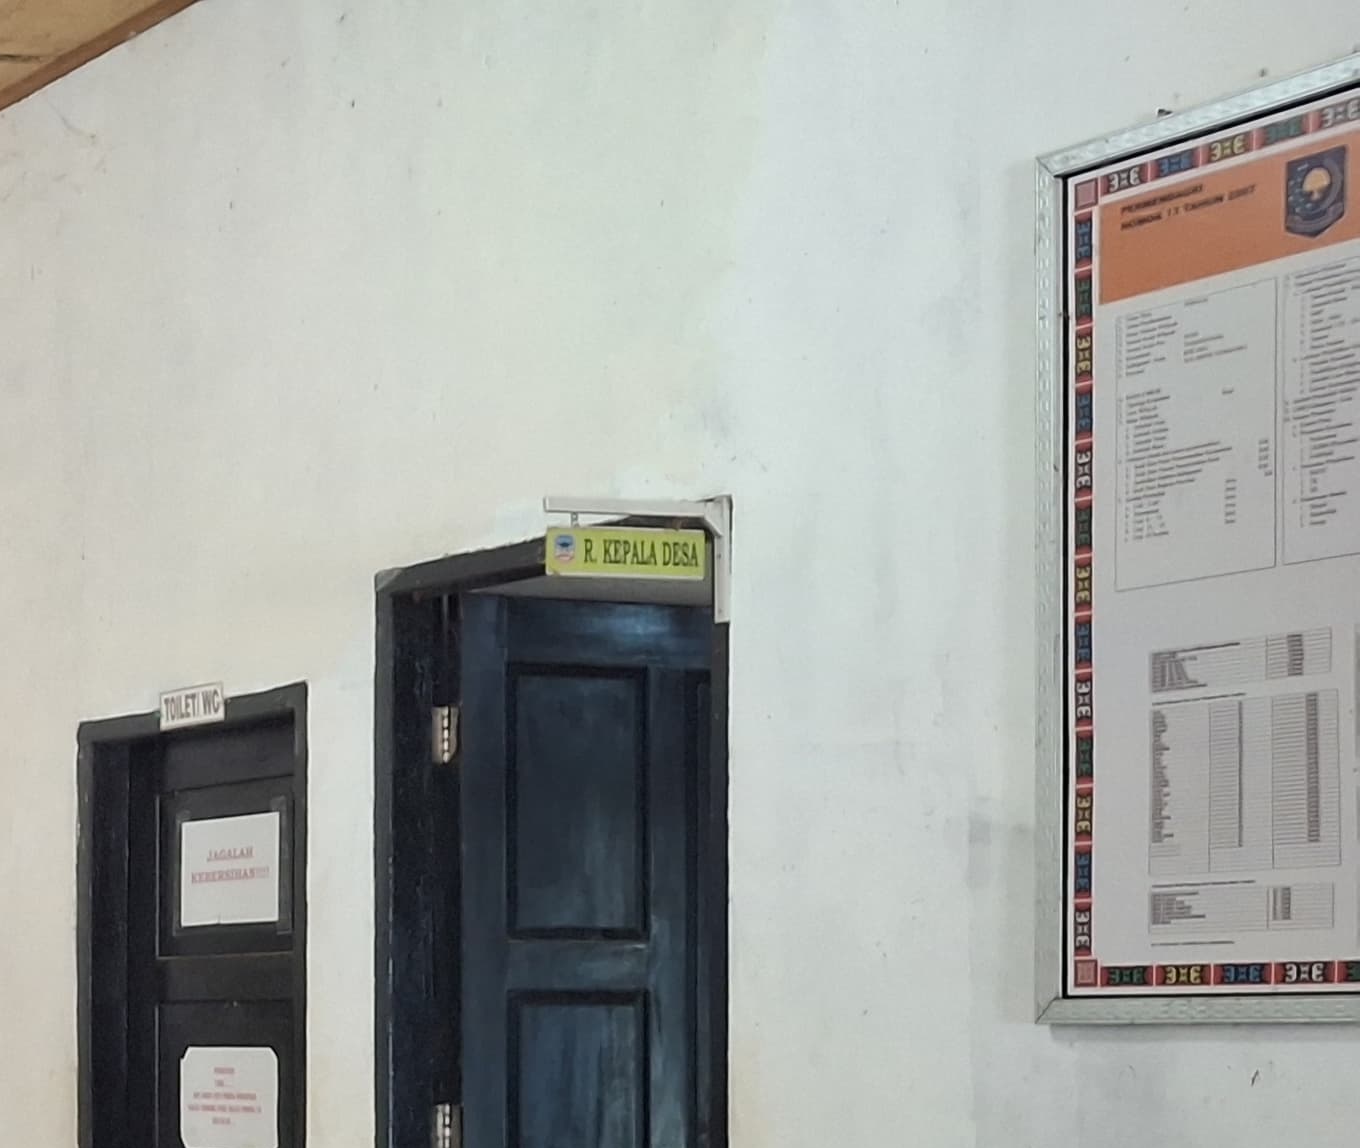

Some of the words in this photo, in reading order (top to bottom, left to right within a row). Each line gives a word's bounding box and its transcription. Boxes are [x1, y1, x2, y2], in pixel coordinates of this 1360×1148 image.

[583, 538, 597, 564] R.
[603, 539, 658, 566] KEPALA
[662, 541, 698, 567] DESA
